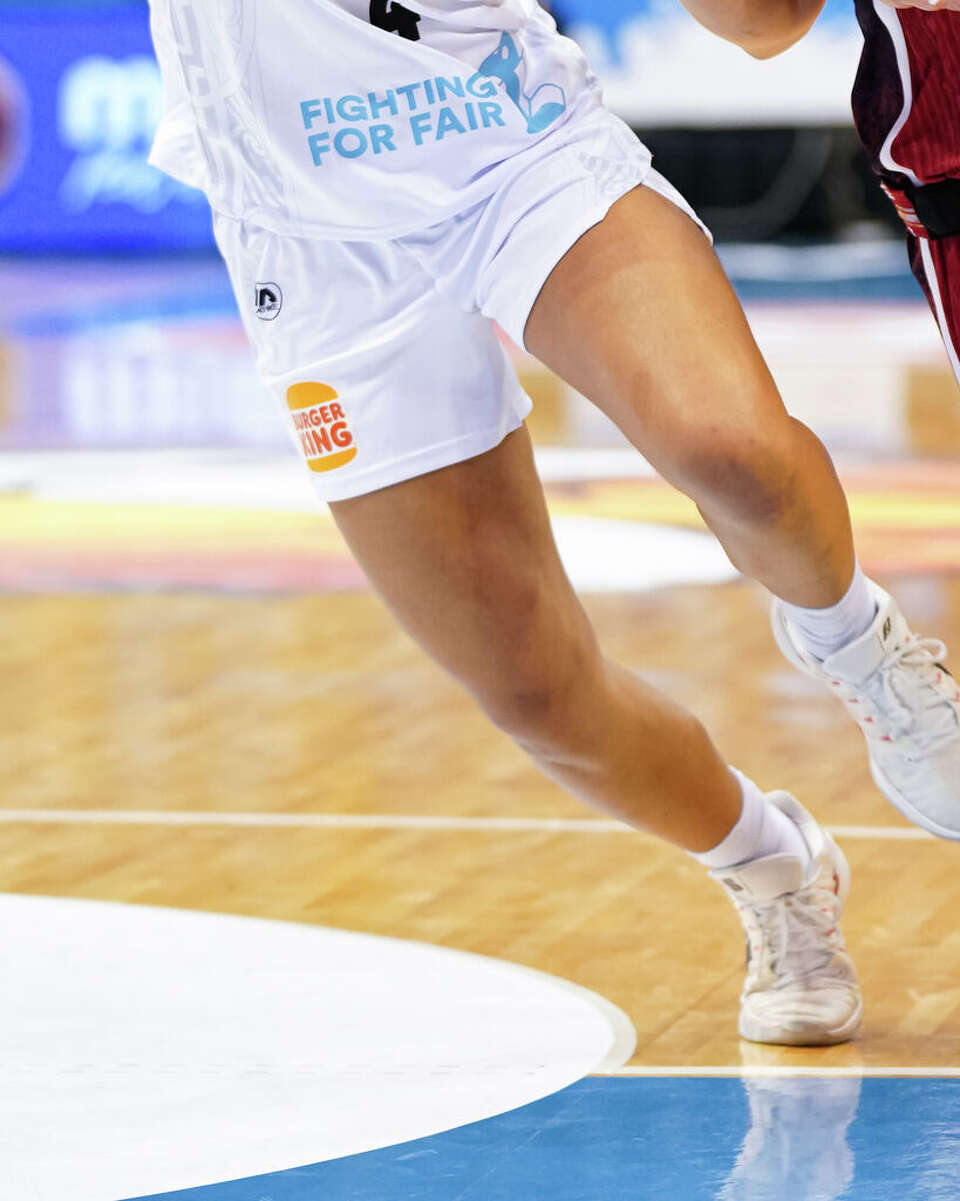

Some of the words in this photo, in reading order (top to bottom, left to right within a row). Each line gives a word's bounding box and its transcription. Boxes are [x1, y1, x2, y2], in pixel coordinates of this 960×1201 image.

[300, 72, 497, 129] FIGHTING
[308, 124, 397, 167] FOR
[409, 102, 506, 146] FAIR
[291, 402, 345, 431] URGER
